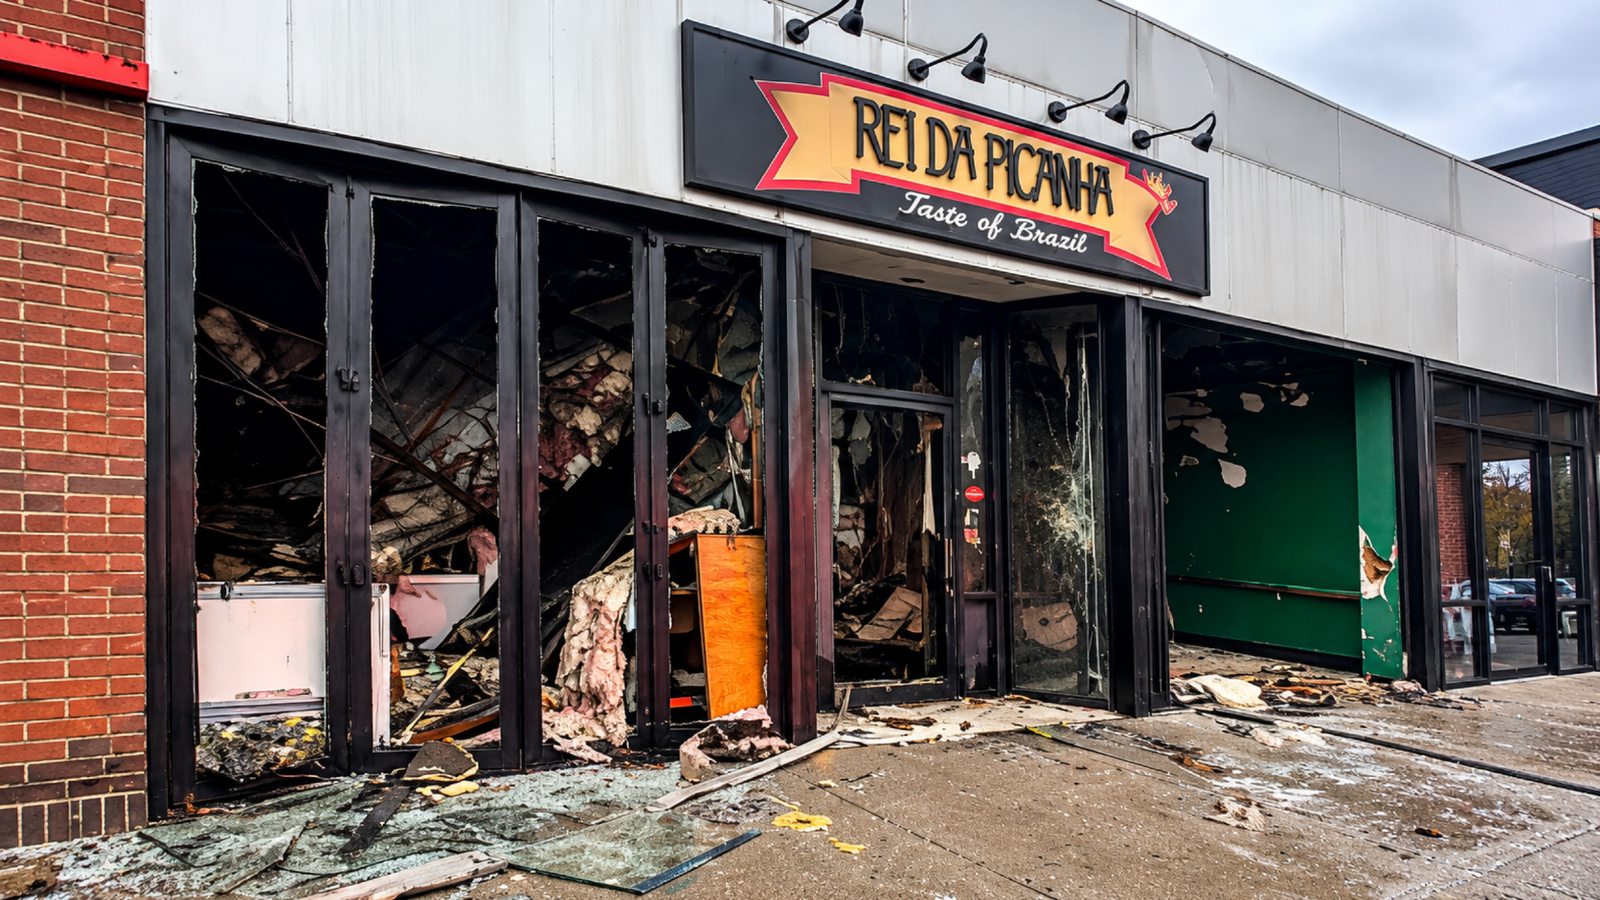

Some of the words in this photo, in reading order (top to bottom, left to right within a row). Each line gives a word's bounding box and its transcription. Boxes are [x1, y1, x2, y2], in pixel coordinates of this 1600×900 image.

[854, 96, 917, 172] REI
[926, 116, 977, 180] DA
[985, 132, 1114, 217] PICANHA
[898, 191, 968, 228] Taste
[977, 213, 1002, 242] of
[1010, 219, 1088, 254] Brazil
